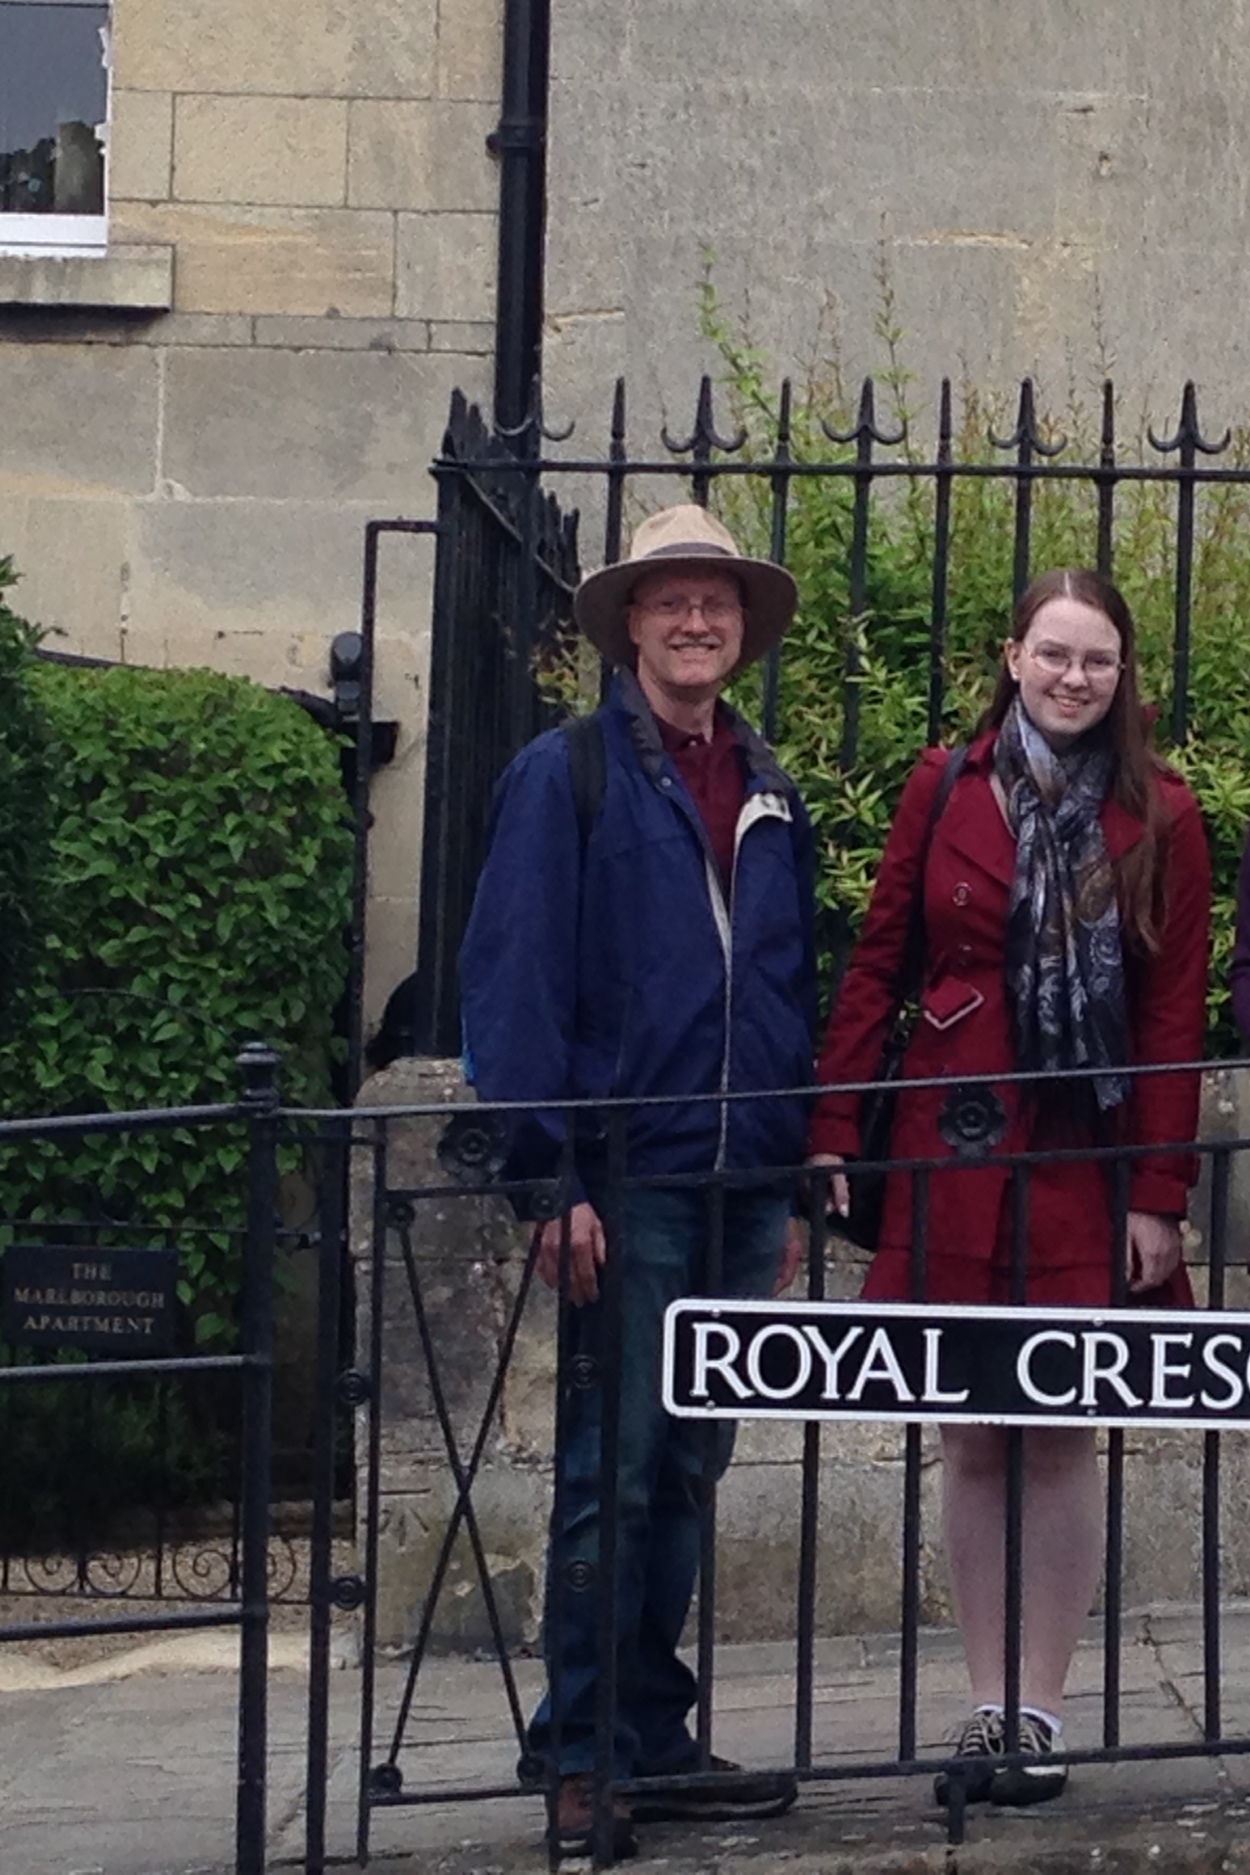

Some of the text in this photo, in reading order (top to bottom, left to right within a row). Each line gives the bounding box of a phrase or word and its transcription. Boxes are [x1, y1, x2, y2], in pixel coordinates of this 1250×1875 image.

[72, 1263, 112, 1280] THE
[14, 1287, 165, 1308] MARLBOROUGH
[23, 1315, 155, 1334] APARTMENT
[690, 1322, 969, 1403] ROYAL
